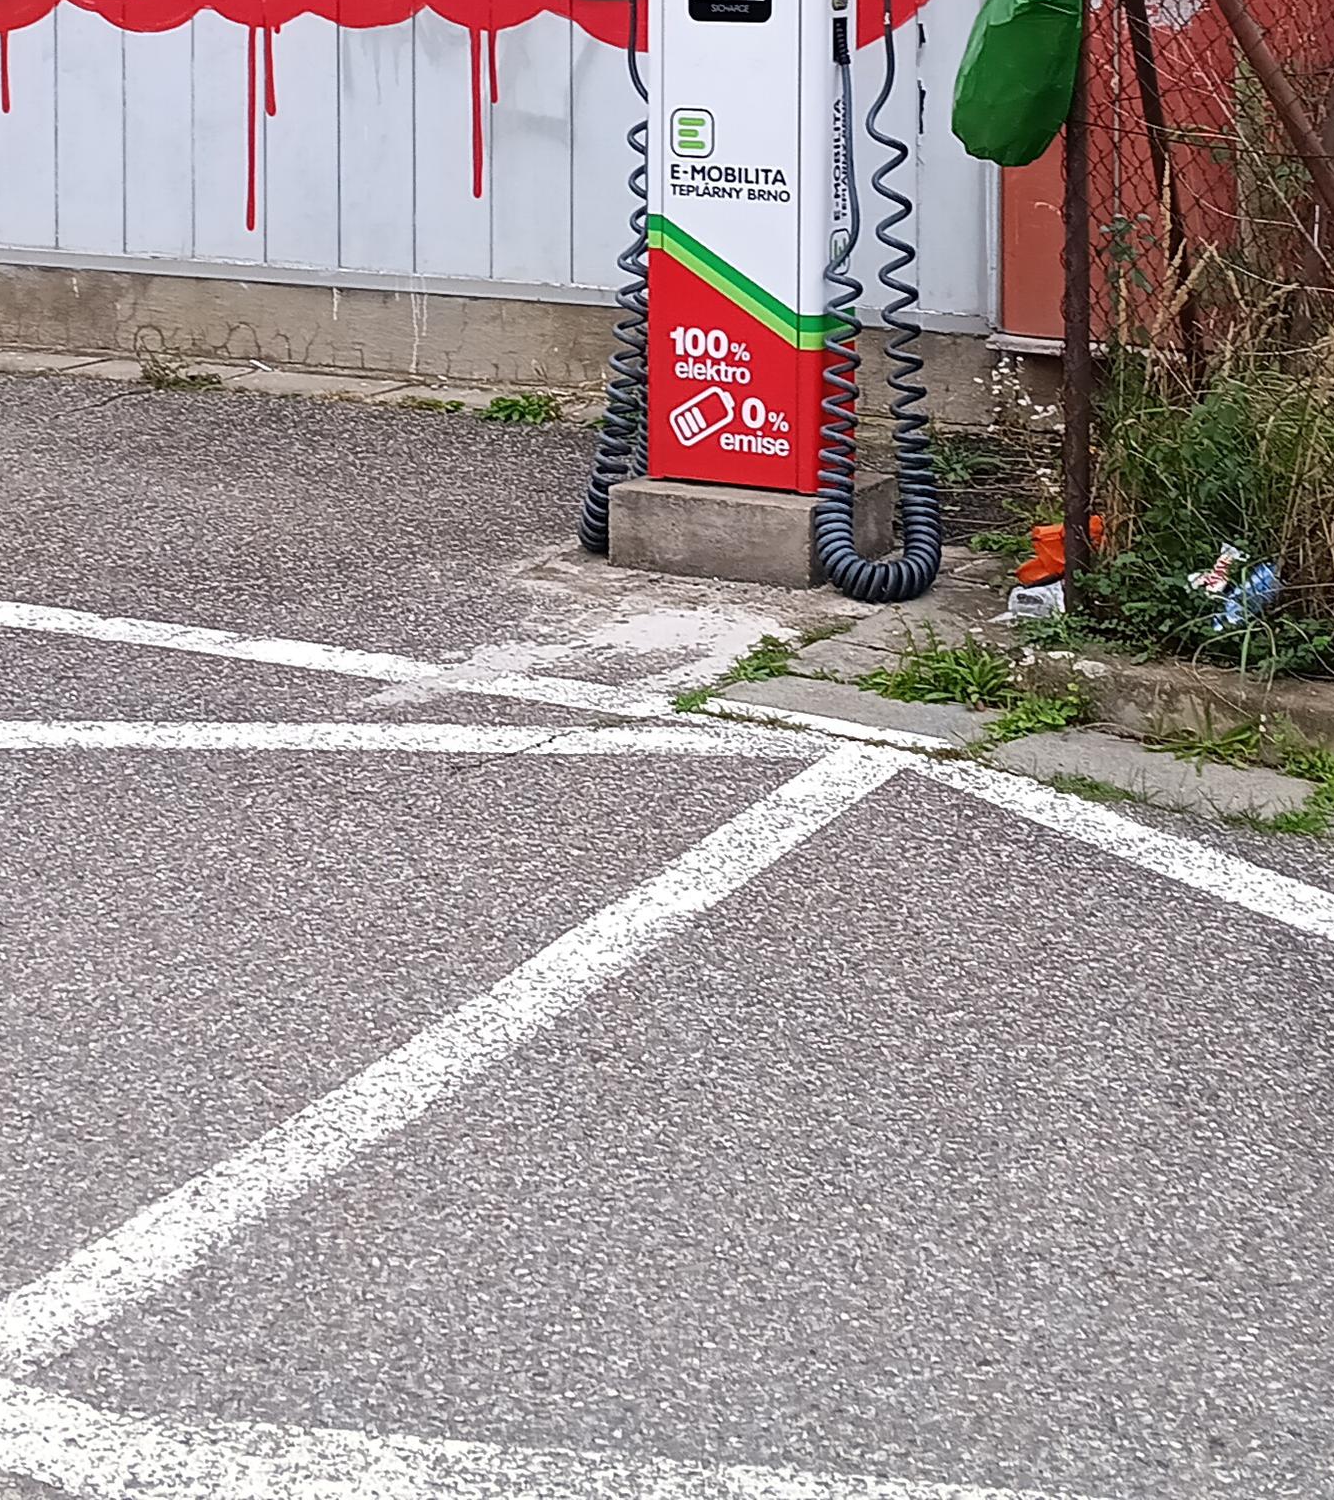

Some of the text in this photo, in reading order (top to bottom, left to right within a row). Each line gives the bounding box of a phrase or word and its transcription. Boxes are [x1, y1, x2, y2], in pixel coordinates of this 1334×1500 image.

[670, 164, 787, 186] E-MOBILITA
[670, 182, 791, 203] TEPLÁRNY BRNO
[669, 326, 751, 361] 100%
[674, 357, 751, 384] elektro
[741, 397, 790, 432] 0%
[719, 431, 790, 457] emise
